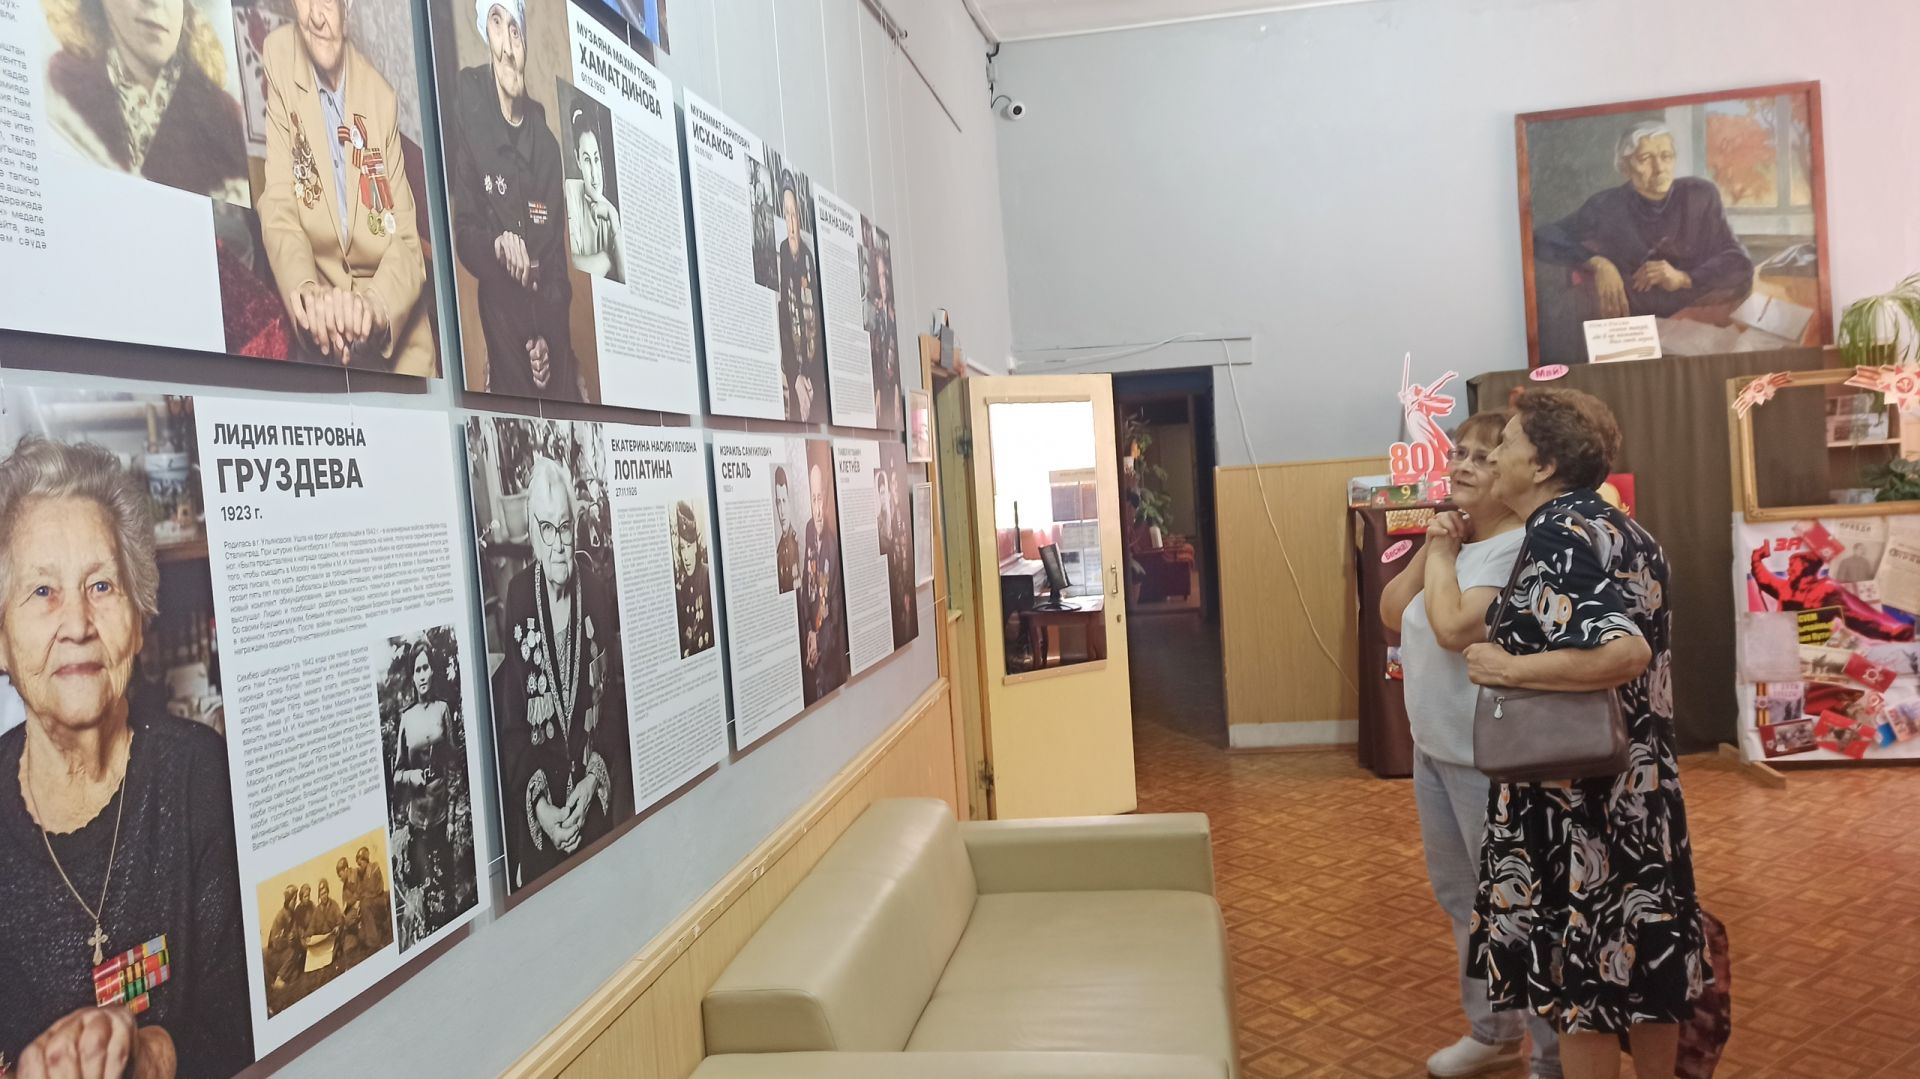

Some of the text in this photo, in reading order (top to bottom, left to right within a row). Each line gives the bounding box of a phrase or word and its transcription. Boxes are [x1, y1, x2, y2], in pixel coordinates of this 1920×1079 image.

[576, 20, 656, 91] МУЗАЯНА МАХМУТОВНА
[579, 42, 662, 120] ХАМАТДИНОВА
[692, 120, 734, 160] ИСХАКОВ
[214, 423, 366, 450] ЛИДИЯ ПЕТРОВНА
[611, 439, 698, 453] ЕКАТЕРИНА НАСИБУЛЛОВНА
[614, 459, 673, 480] ЛОПАТИНА
[721, 462, 751, 479] СЕГАЛЬ
[1389, 441, 1430, 476] 80
[217, 457, 364, 498] ГРУЗДЕВА
[1401, 485, 1411, 500] 9
[220, 505, 263, 521] 1923 г.
